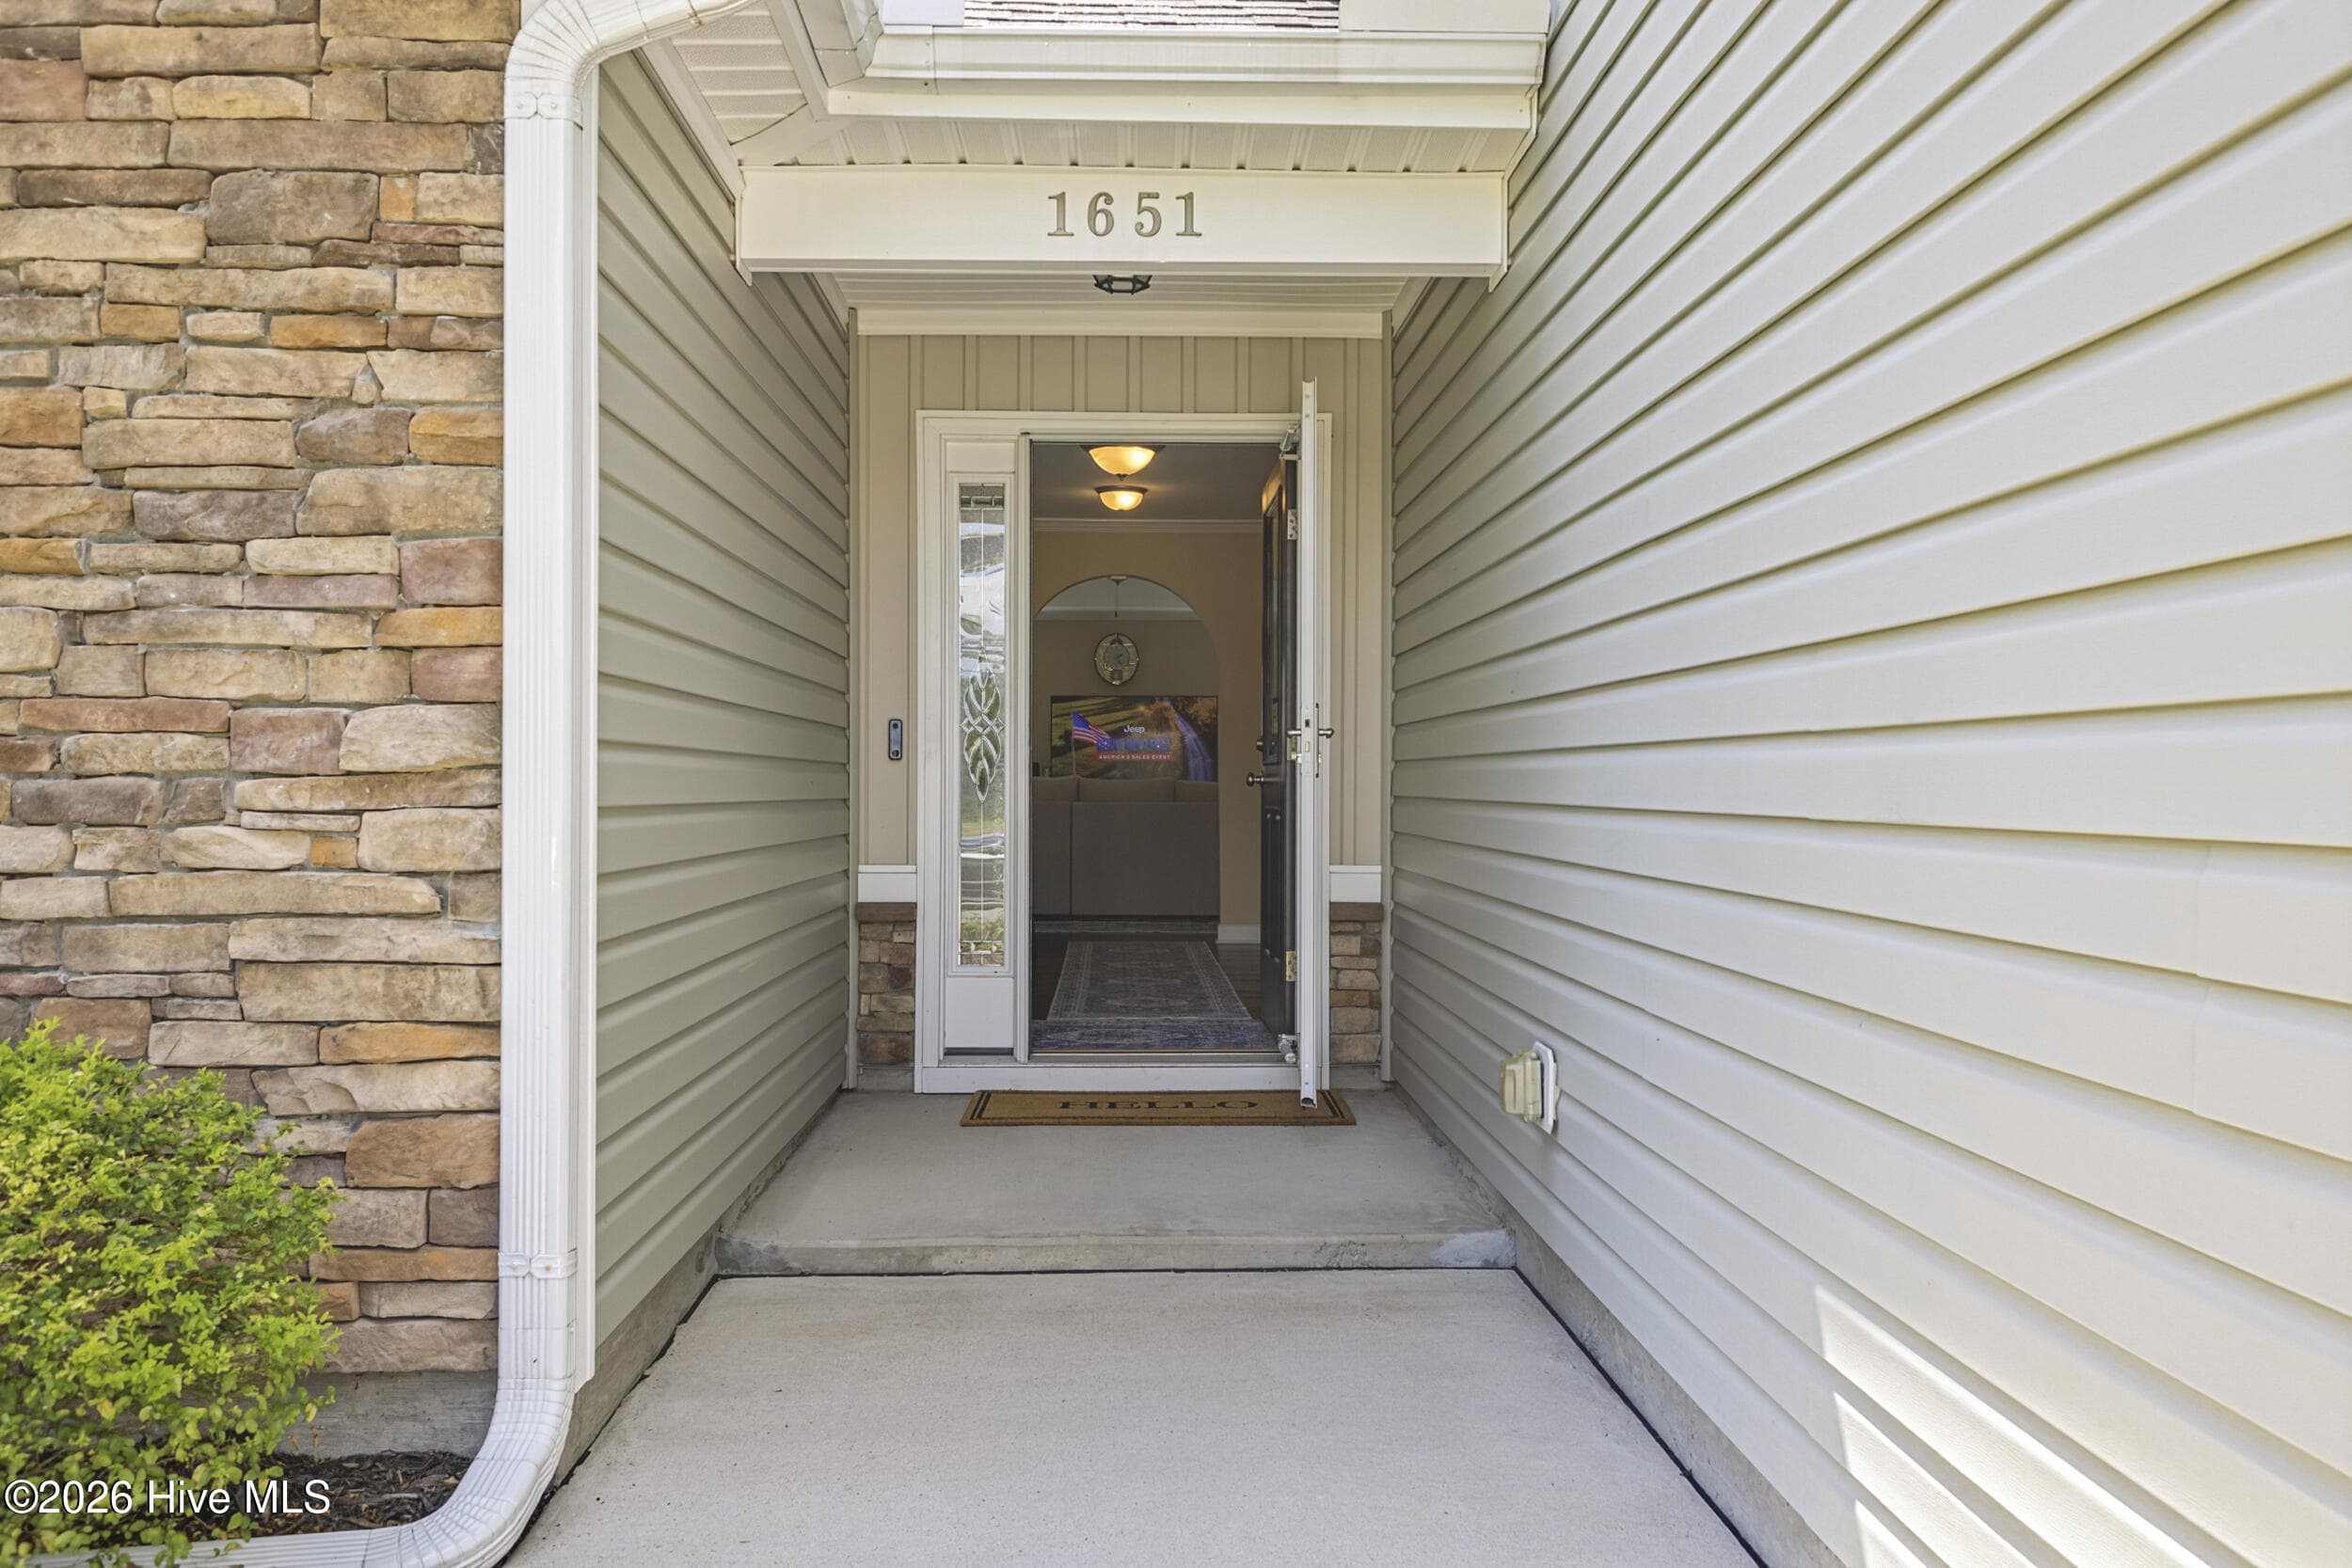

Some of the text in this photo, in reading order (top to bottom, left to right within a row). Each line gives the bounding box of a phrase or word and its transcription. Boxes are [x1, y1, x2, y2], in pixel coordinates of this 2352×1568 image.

[1047, 191, 1202, 237] 1651
[1123, 725, 1145, 734] Jeep
[1060, 1101, 1259, 1110] HELLO
